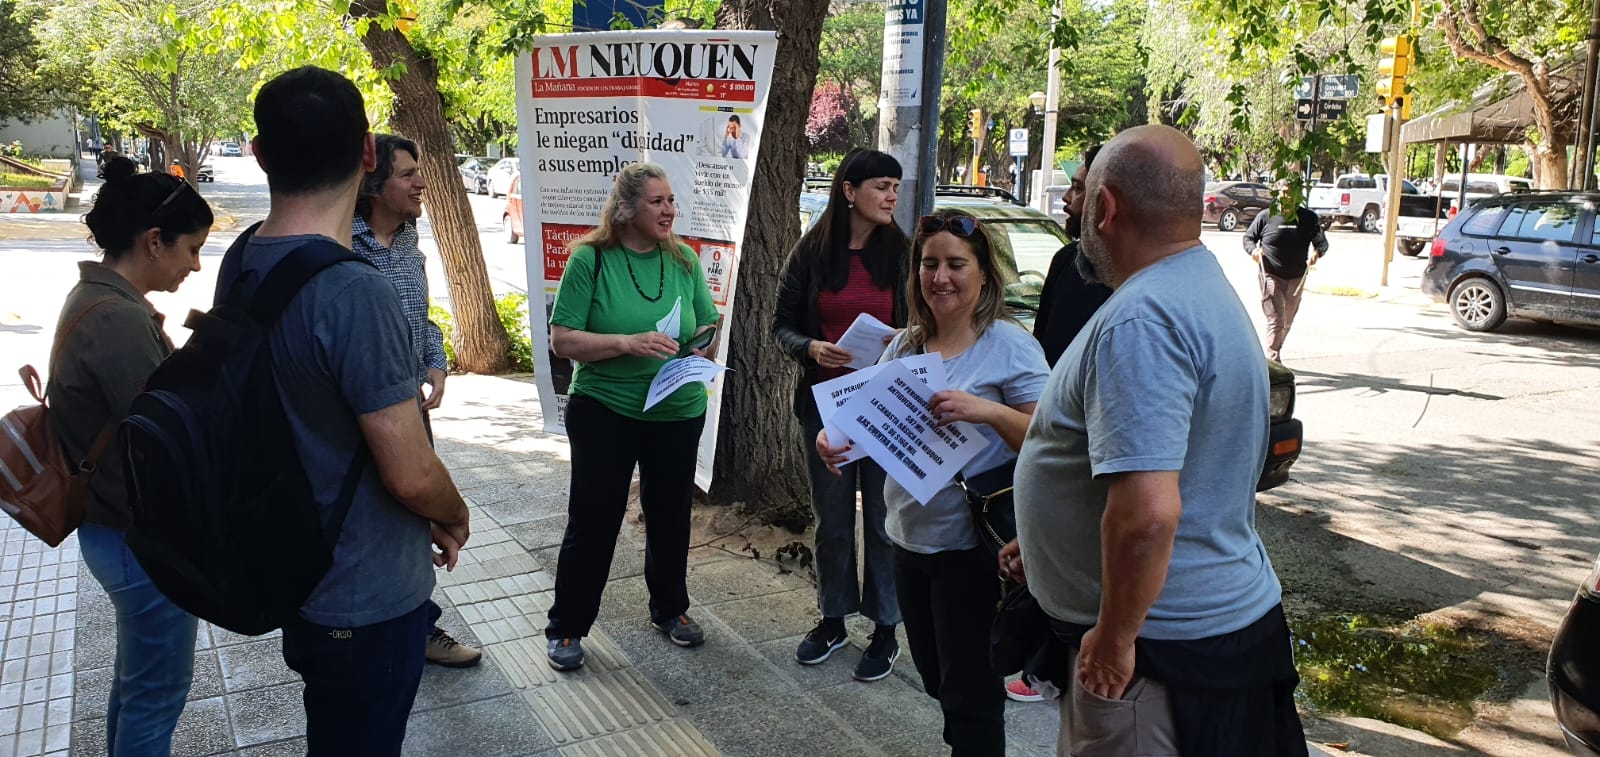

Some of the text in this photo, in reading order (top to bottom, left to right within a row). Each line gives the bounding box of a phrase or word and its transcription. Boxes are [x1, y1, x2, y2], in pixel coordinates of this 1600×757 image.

[906, 9, 918, 19] YA
[531, 46, 580, 78] LM
[534, 82, 544, 92] La
[546, 82, 576, 92] Mañana
[535, 106, 638, 128] Empresarios
[536, 131, 550, 148] le
[554, 131, 608, 152] niegan
[538, 158, 547, 172] a
[548, 158, 576, 172] sus
[547, 256, 556, 268] la
[831, 389, 842, 398] SOY
[894, 378, 906, 387] SOY
[958, 435, 968, 443] DE
[870, 398, 879, 406] LA
[876, 404, 899, 425] CANASTA
[914, 438, 923, 446] EN
[920, 444, 944, 465] NEUQUÉN
[914, 423, 925, 434] MIL
[867, 424, 891, 446] CUENTAS
[888, 443, 898, 453] NO
[895, 450, 905, 460] ME
[881, 422, 890, 430] ES
[887, 428, 897, 437] DE
[906, 445, 916, 455] MIL
[943, 435, 952, 443] ES
[949, 441, 958, 449] DE
